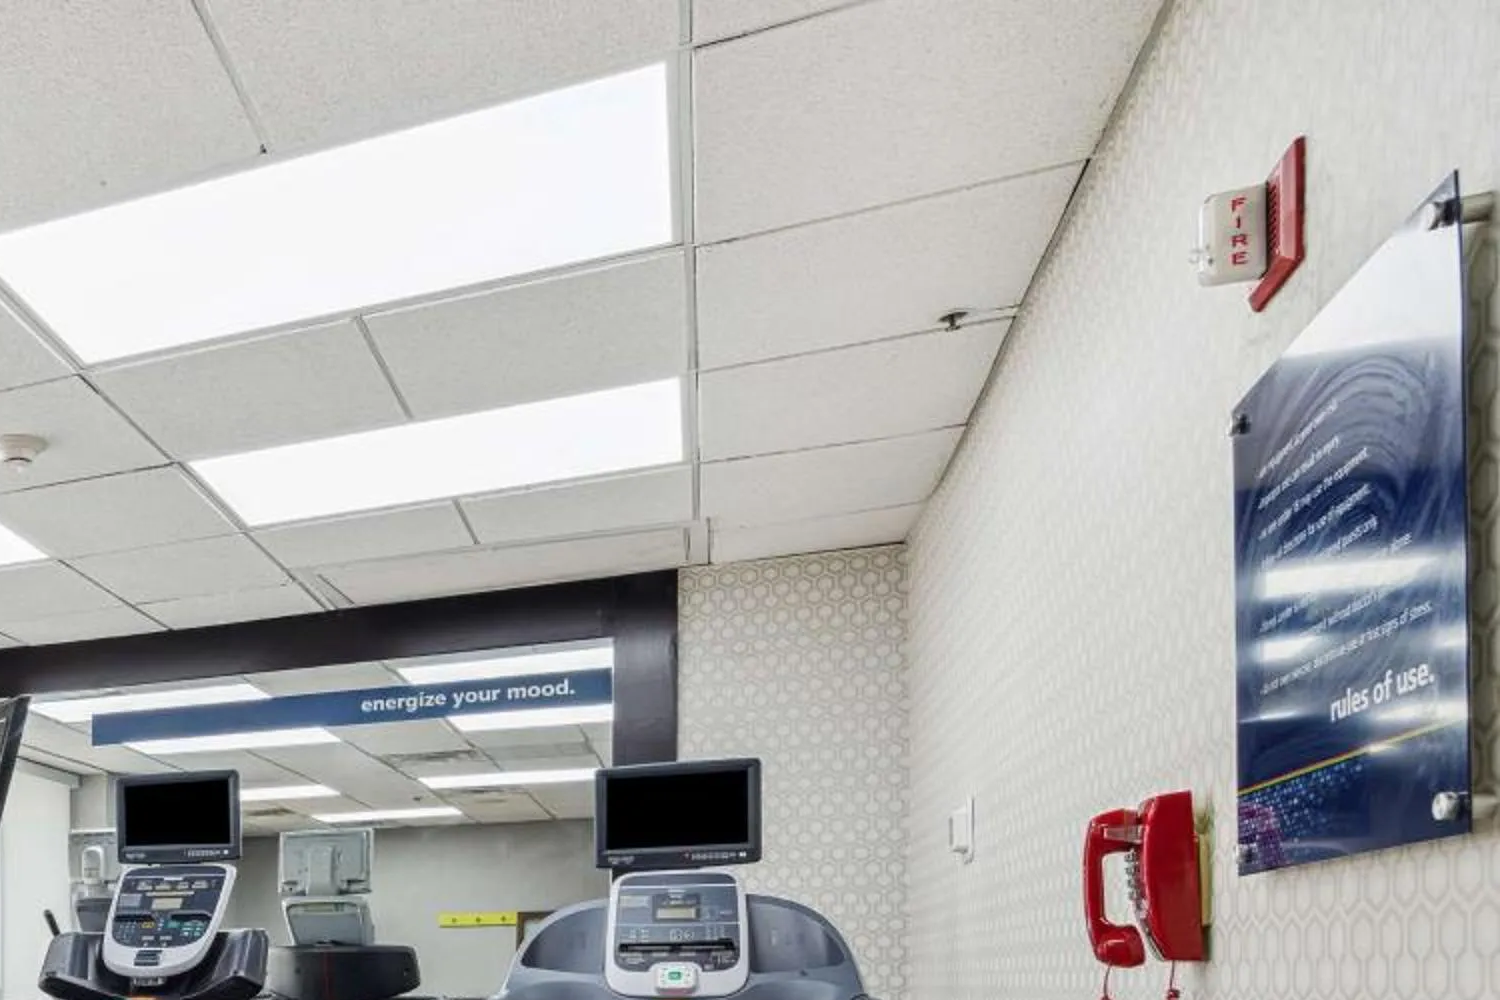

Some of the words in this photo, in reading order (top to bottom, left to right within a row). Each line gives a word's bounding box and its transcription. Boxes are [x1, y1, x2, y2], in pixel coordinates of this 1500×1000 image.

[1231, 197, 1247, 265] FIRE
[361, 692, 447, 713] energize
[453, 688, 500, 709] your
[507, 678, 576, 699] mood.
[1330, 688, 1369, 723] rules
[1373, 669, 1393, 704] of
[1397, 662, 1435, 695] use.
